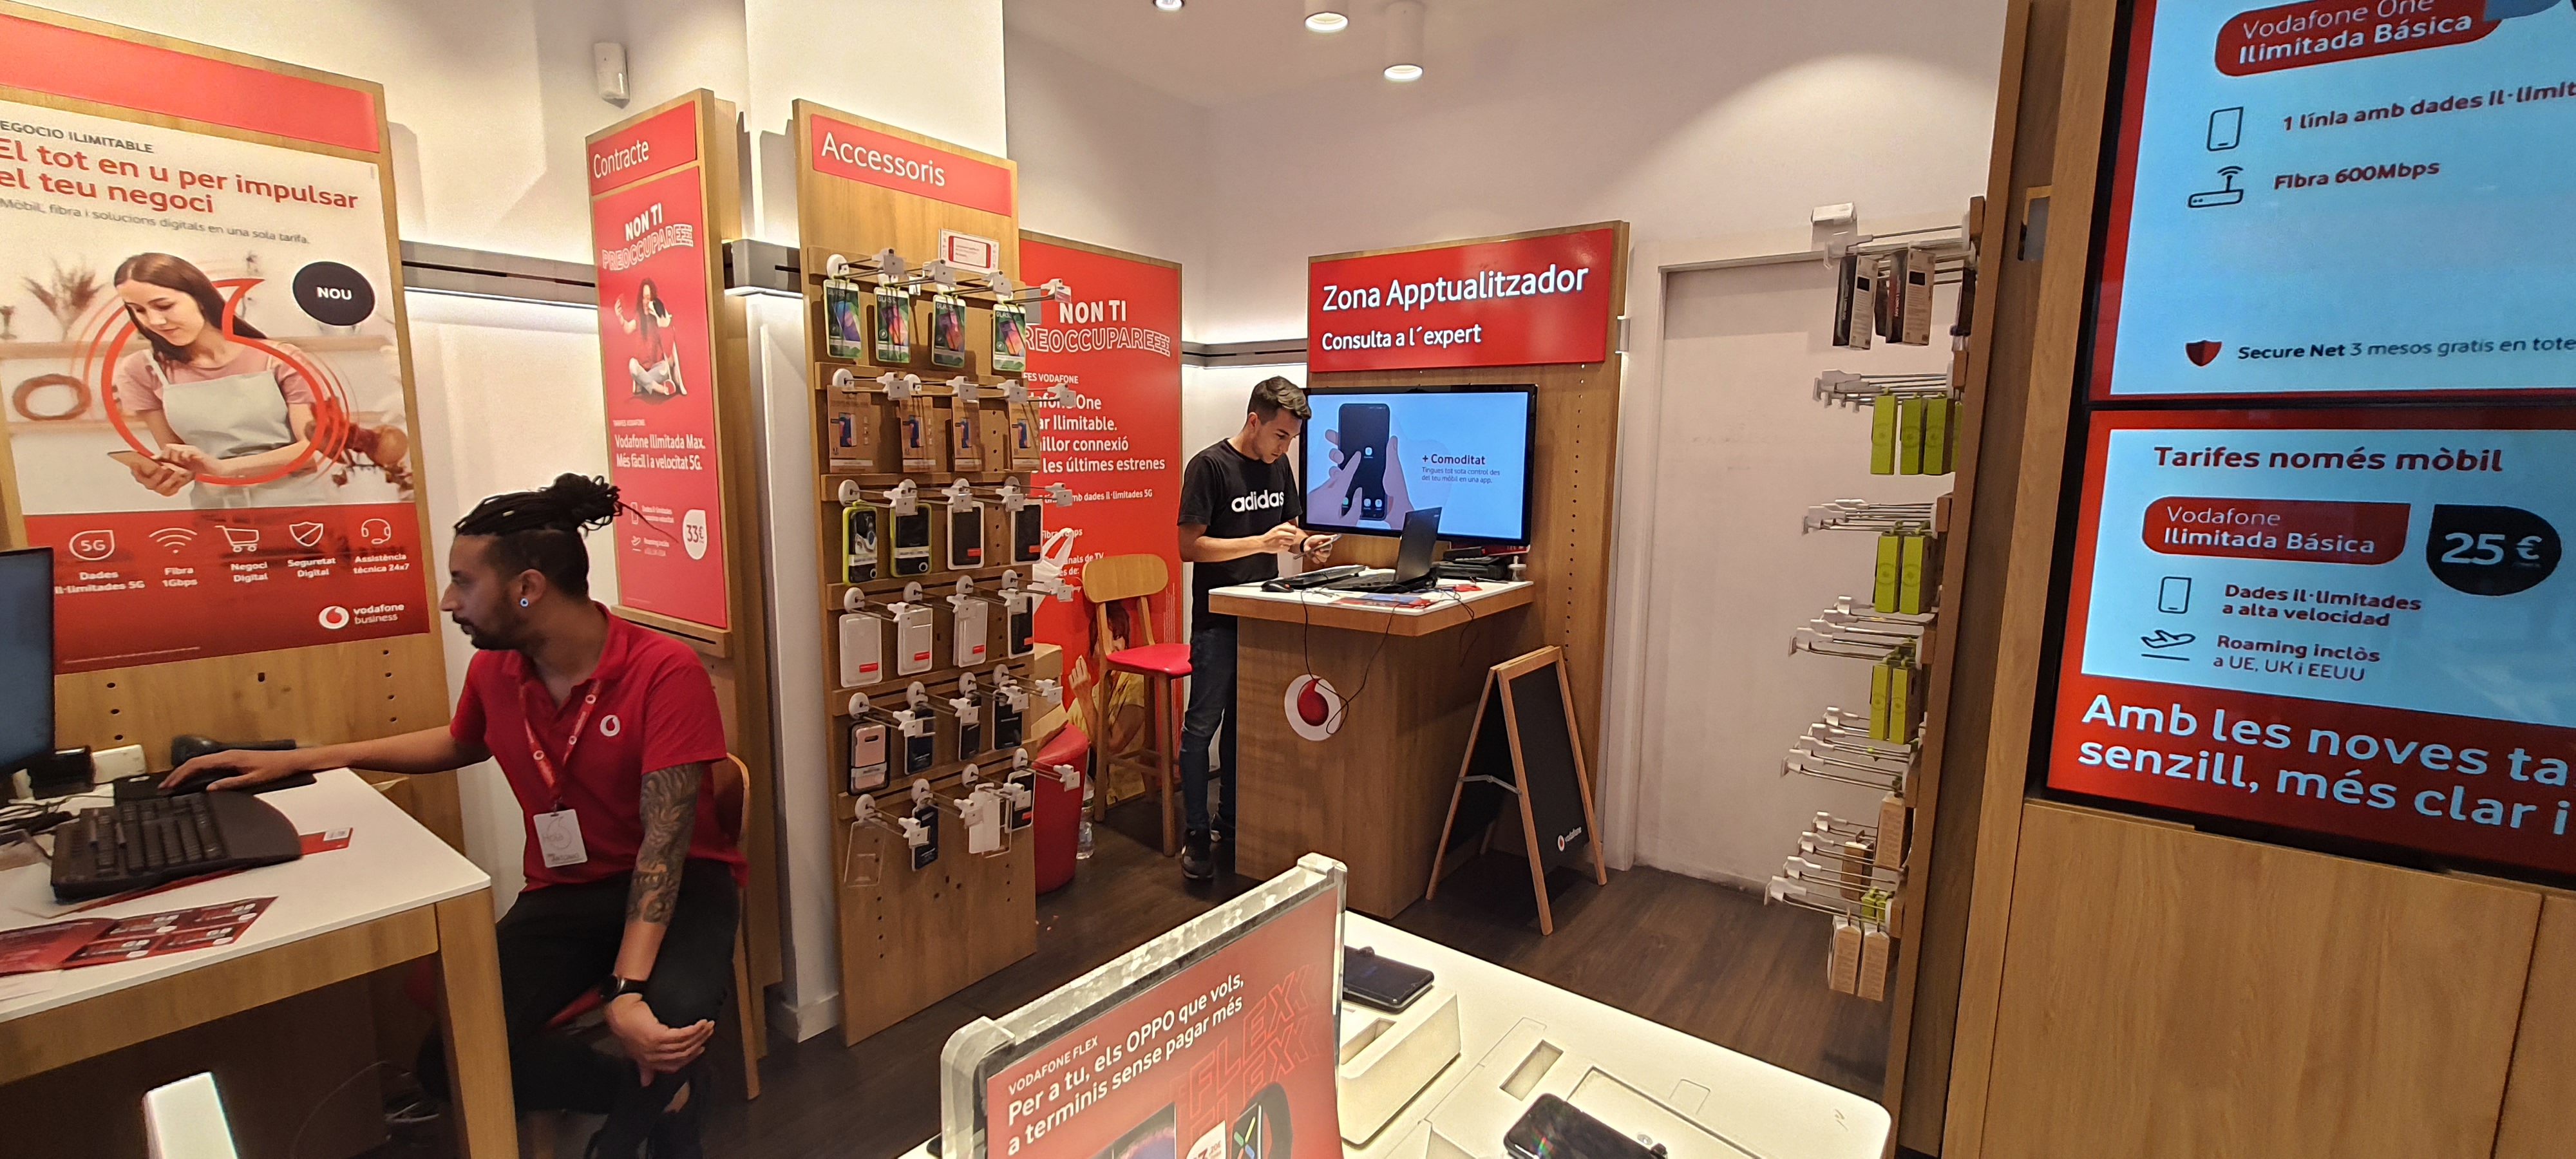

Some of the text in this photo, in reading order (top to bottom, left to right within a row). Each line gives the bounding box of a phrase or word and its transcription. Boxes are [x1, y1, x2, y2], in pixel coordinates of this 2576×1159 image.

[2243, 0, 2433, 39] Vodafone One
[2239, 14, 2473, 65] Ilimitada Básica
[2283, 116, 2293, 131] 1
[2300, 109, 2348, 129] línia
[2353, 102, 2405, 124] amb
[2410, 92, 2483, 116] dades
[0, 120, 155, 153] EGOCIO ILIMITABLE
[593, 140, 650, 179] Contracte
[821, 131, 945, 187] Accessoris
[0, 137, 358, 209] El tot en u per impulsar
[2274, 162, 2441, 191] Fibra 600Mbps
[0, 168, 214, 212] el teu negoci
[50, 204, 81, 217] fibra
[92, 211, 156, 226] solucions
[160, 218, 205, 232] digitals
[208, 225, 223, 234] en
[227, 227, 249, 238] una
[252, 229, 276, 241] sola
[279, 233, 310, 245] tarifa.
[625, 202, 663, 241] NON TI
[317, 285, 352, 301] NOU
[1322, 263, 1589, 312] Zona Apptualitzador
[936, 303, 954, 311] GLAS
[1059, 299, 1126, 325] NON TI
[1321, 330, 1392, 351] Consulta
[1395, 335, 1405, 347] a
[2237, 337, 2576, 361] Secure Net 3 mesos gratis en tote
[1038, 373, 1079, 384] VODAFONE
[1076, 393, 1102, 410] One
[1053, 414, 1117, 431] Ilimitable.
[614, 433, 706, 449] Vodafone Ilimitada Max.
[1040, 436, 1129, 452] illor connexió
[616, 452, 631, 468] Més
[650, 457, 655, 469] a
[655, 454, 689, 470] velocitat
[689, 454, 703, 471] 5G.
[1043, 456, 1166, 473] les últimes estrenes
[1431, 453, 1486, 466] Comoditat
[2154, 445, 2503, 473] Tarifes només mòbil
[1422, 467, 1444, 475] Tingues
[1072, 494, 1083, 502] mb
[1084, 492, 1105, 502] dades
[1144, 489, 1153, 498] 5G
[1231, 489, 1285, 513] adidas
[2166, 505, 2280, 526] Vodafone
[80, 540, 106, 552] 5G
[2164, 527, 2376, 554] Ilimitada Básica
[2439, 531, 2543, 565] 25 €
[231, 561, 268, 572] Negoci
[287, 557, 336, 568] Seguretat
[388, 563, 410, 572] 24x7
[1084, 554, 1094, 563] de
[1094, 552, 1104, 560] TV
[79, 571, 119, 581] Dades
[164, 567, 194, 576] Fibra
[233, 573, 269, 583] Digital
[297, 569, 330, 578] Digital
[1068, 567, 1079, 576] de:
[129, 580, 146, 589] 5G
[162, 579, 198, 588] 1Gbps
[2224, 583, 2288, 601] Dades
[354, 603, 405, 615] vodafone
[354, 614, 399, 625] business
[2222, 603, 2391, 627] a alta velocidad
[2217, 634, 2381, 663] Roaming inclòs
[2213, 655, 2365, 681] a UE, UK i EEUU
[2081, 693, 2198, 737] Amb
[2212, 708, 2291, 749] les
[2308, 728, 2488, 776] noves
[2078, 740, 2569, 836] senzill, més clar i
[1008, 973, 1244, 1127] Per a tu, els OPPO que vols,
[1008, 1034, 1099, 1096] VODAFONE FLEX
[1008, 995, 1243, 1156] a terminis sense pagar més
